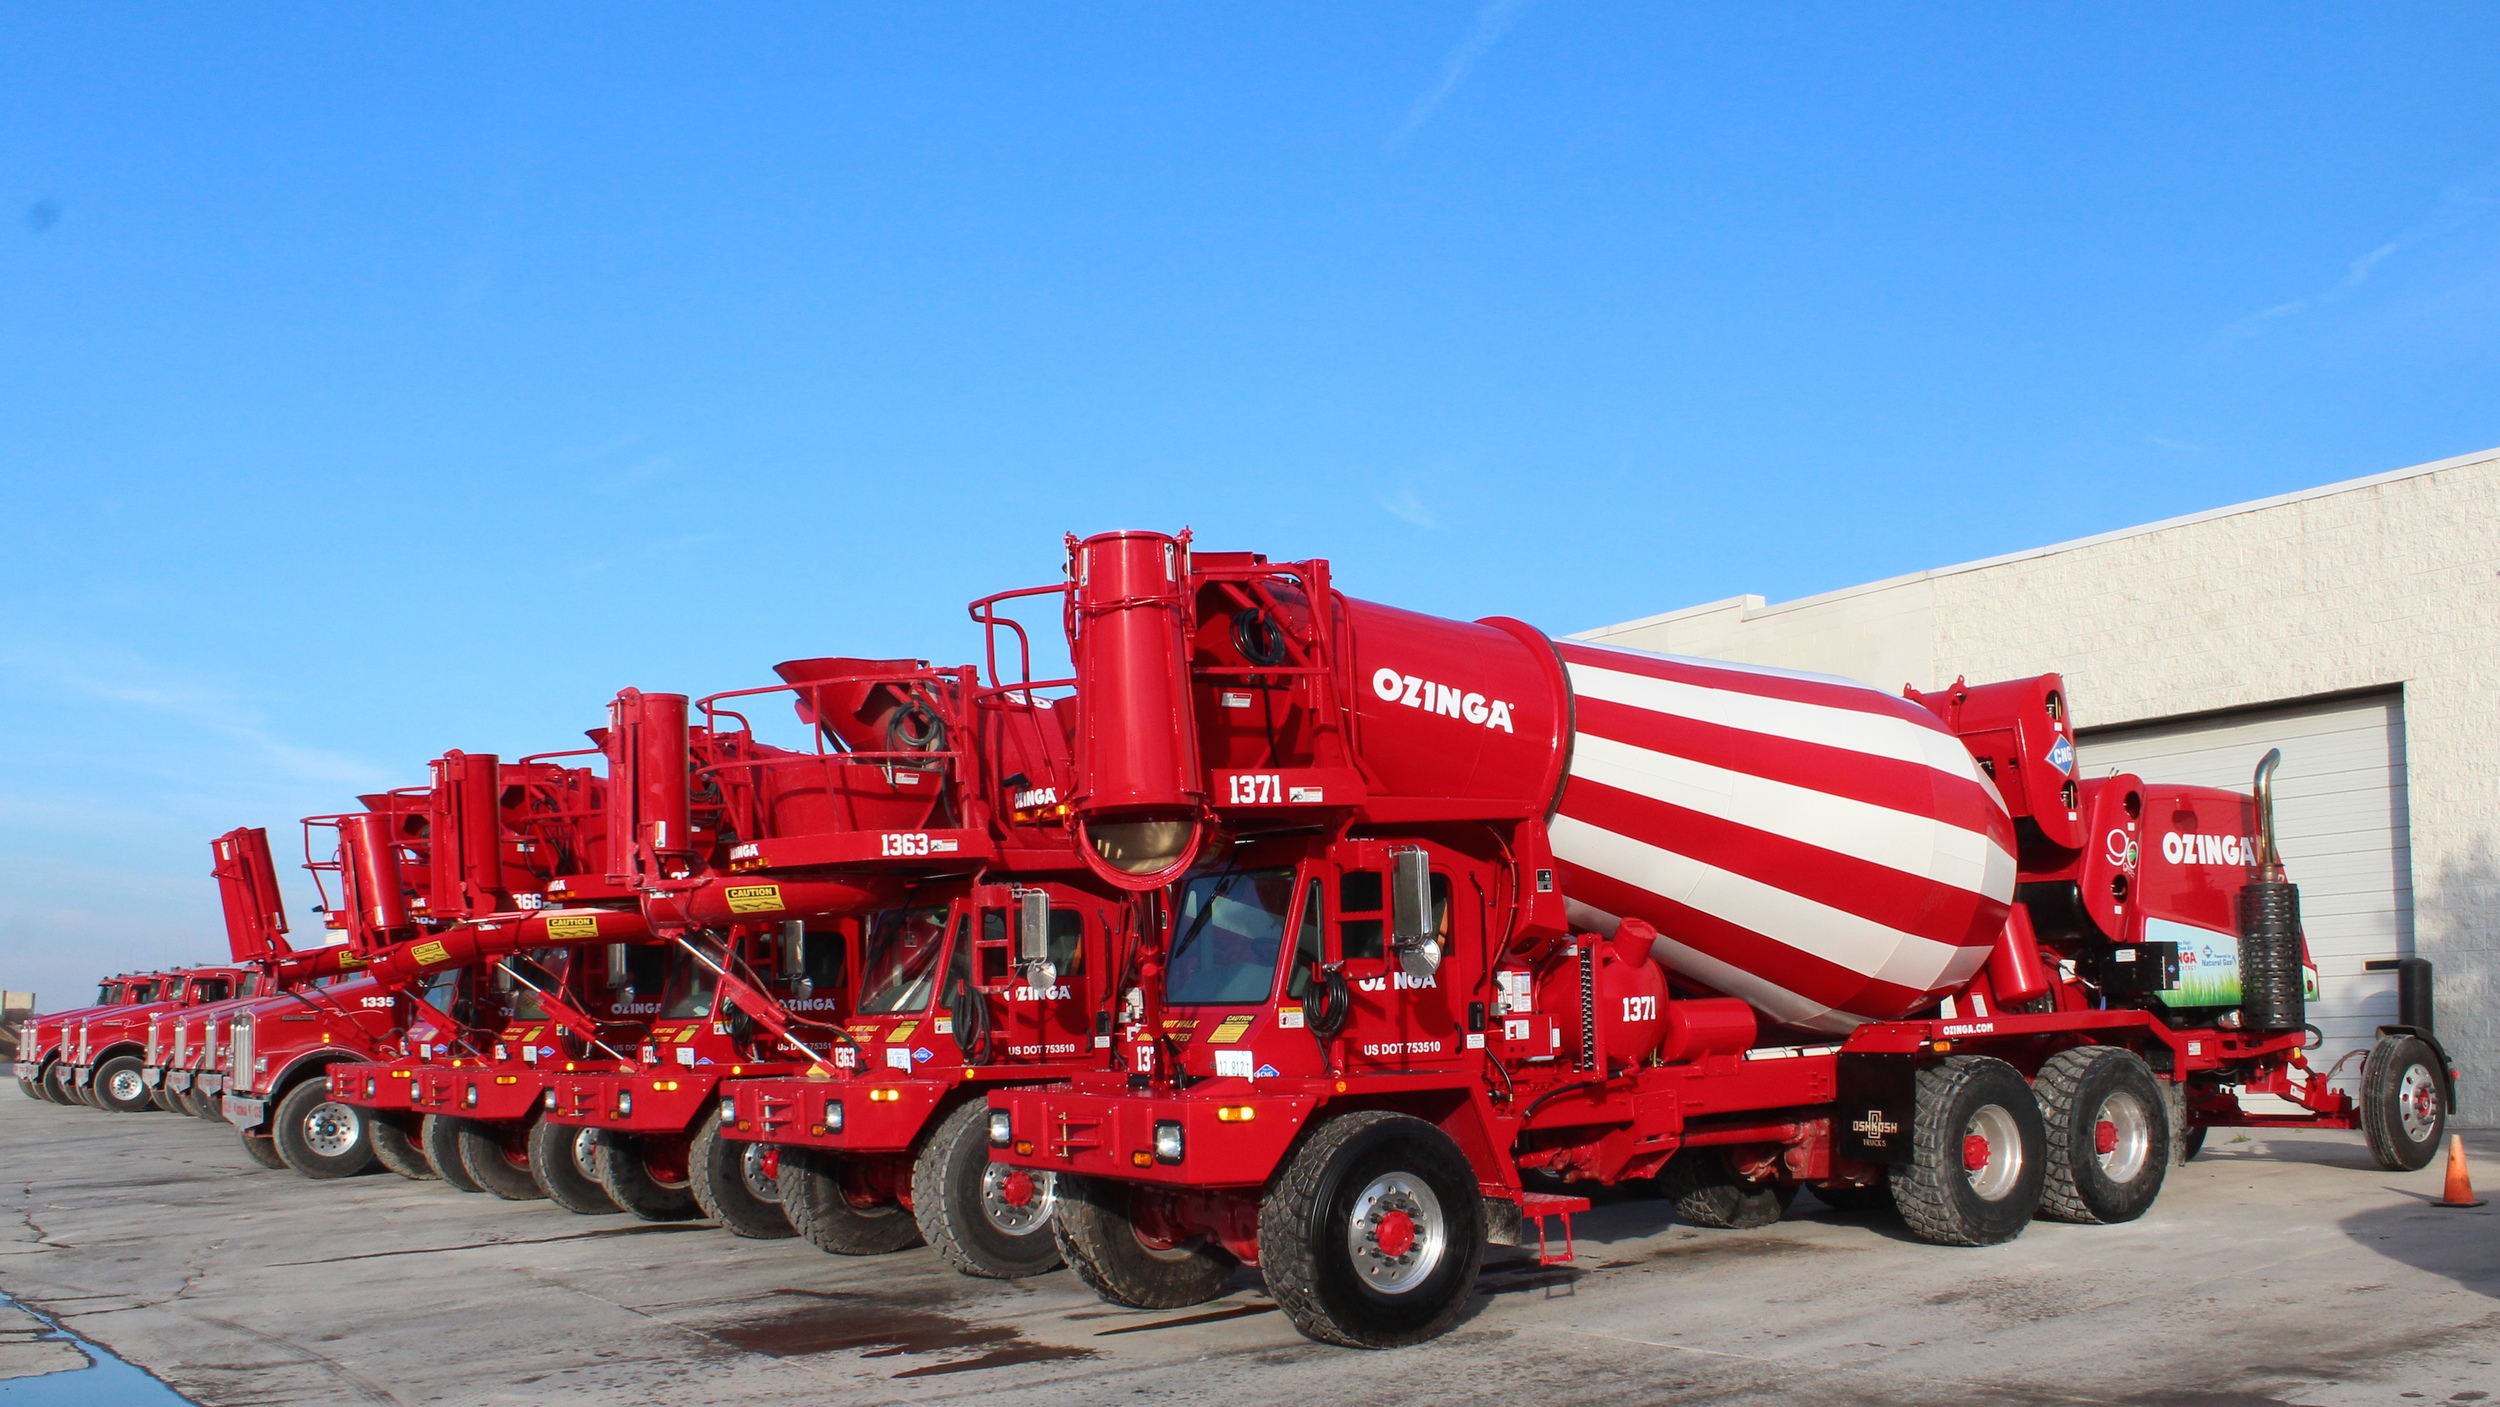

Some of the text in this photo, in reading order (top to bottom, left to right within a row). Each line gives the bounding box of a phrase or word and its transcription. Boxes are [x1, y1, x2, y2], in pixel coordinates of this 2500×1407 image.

[1373, 668, 1514, 733] OZINGA
[2053, 746, 2073, 764] CNG
[1229, 775, 1282, 804] 1371
[881, 833, 929, 856] 1363
[2162, 831, 2257, 867] OZINGA
[730, 887, 774, 898] CAUTION
[512, 893, 542, 910] 366
[551, 918, 591, 926] CAUTION
[2178, 951, 2197, 964] NGA
[1359, 972, 1437, 991] OZNGA
[361, 996, 395, 1008] 1335
[1622, 995, 1656, 1022] 1371
[1162, 1020, 1200, 1028] NOT WALK
[1943, 1022, 1994, 1036] OZINGA.COM
[810, 1042, 831, 1050] 75351
[1008, 1043, 1075, 1055] US DOT 753510
[1364, 1041, 1441, 1056] US DOT 753510
[835, 1047, 855, 1068] 1363
[1137, 1046, 1156, 1071] 13
